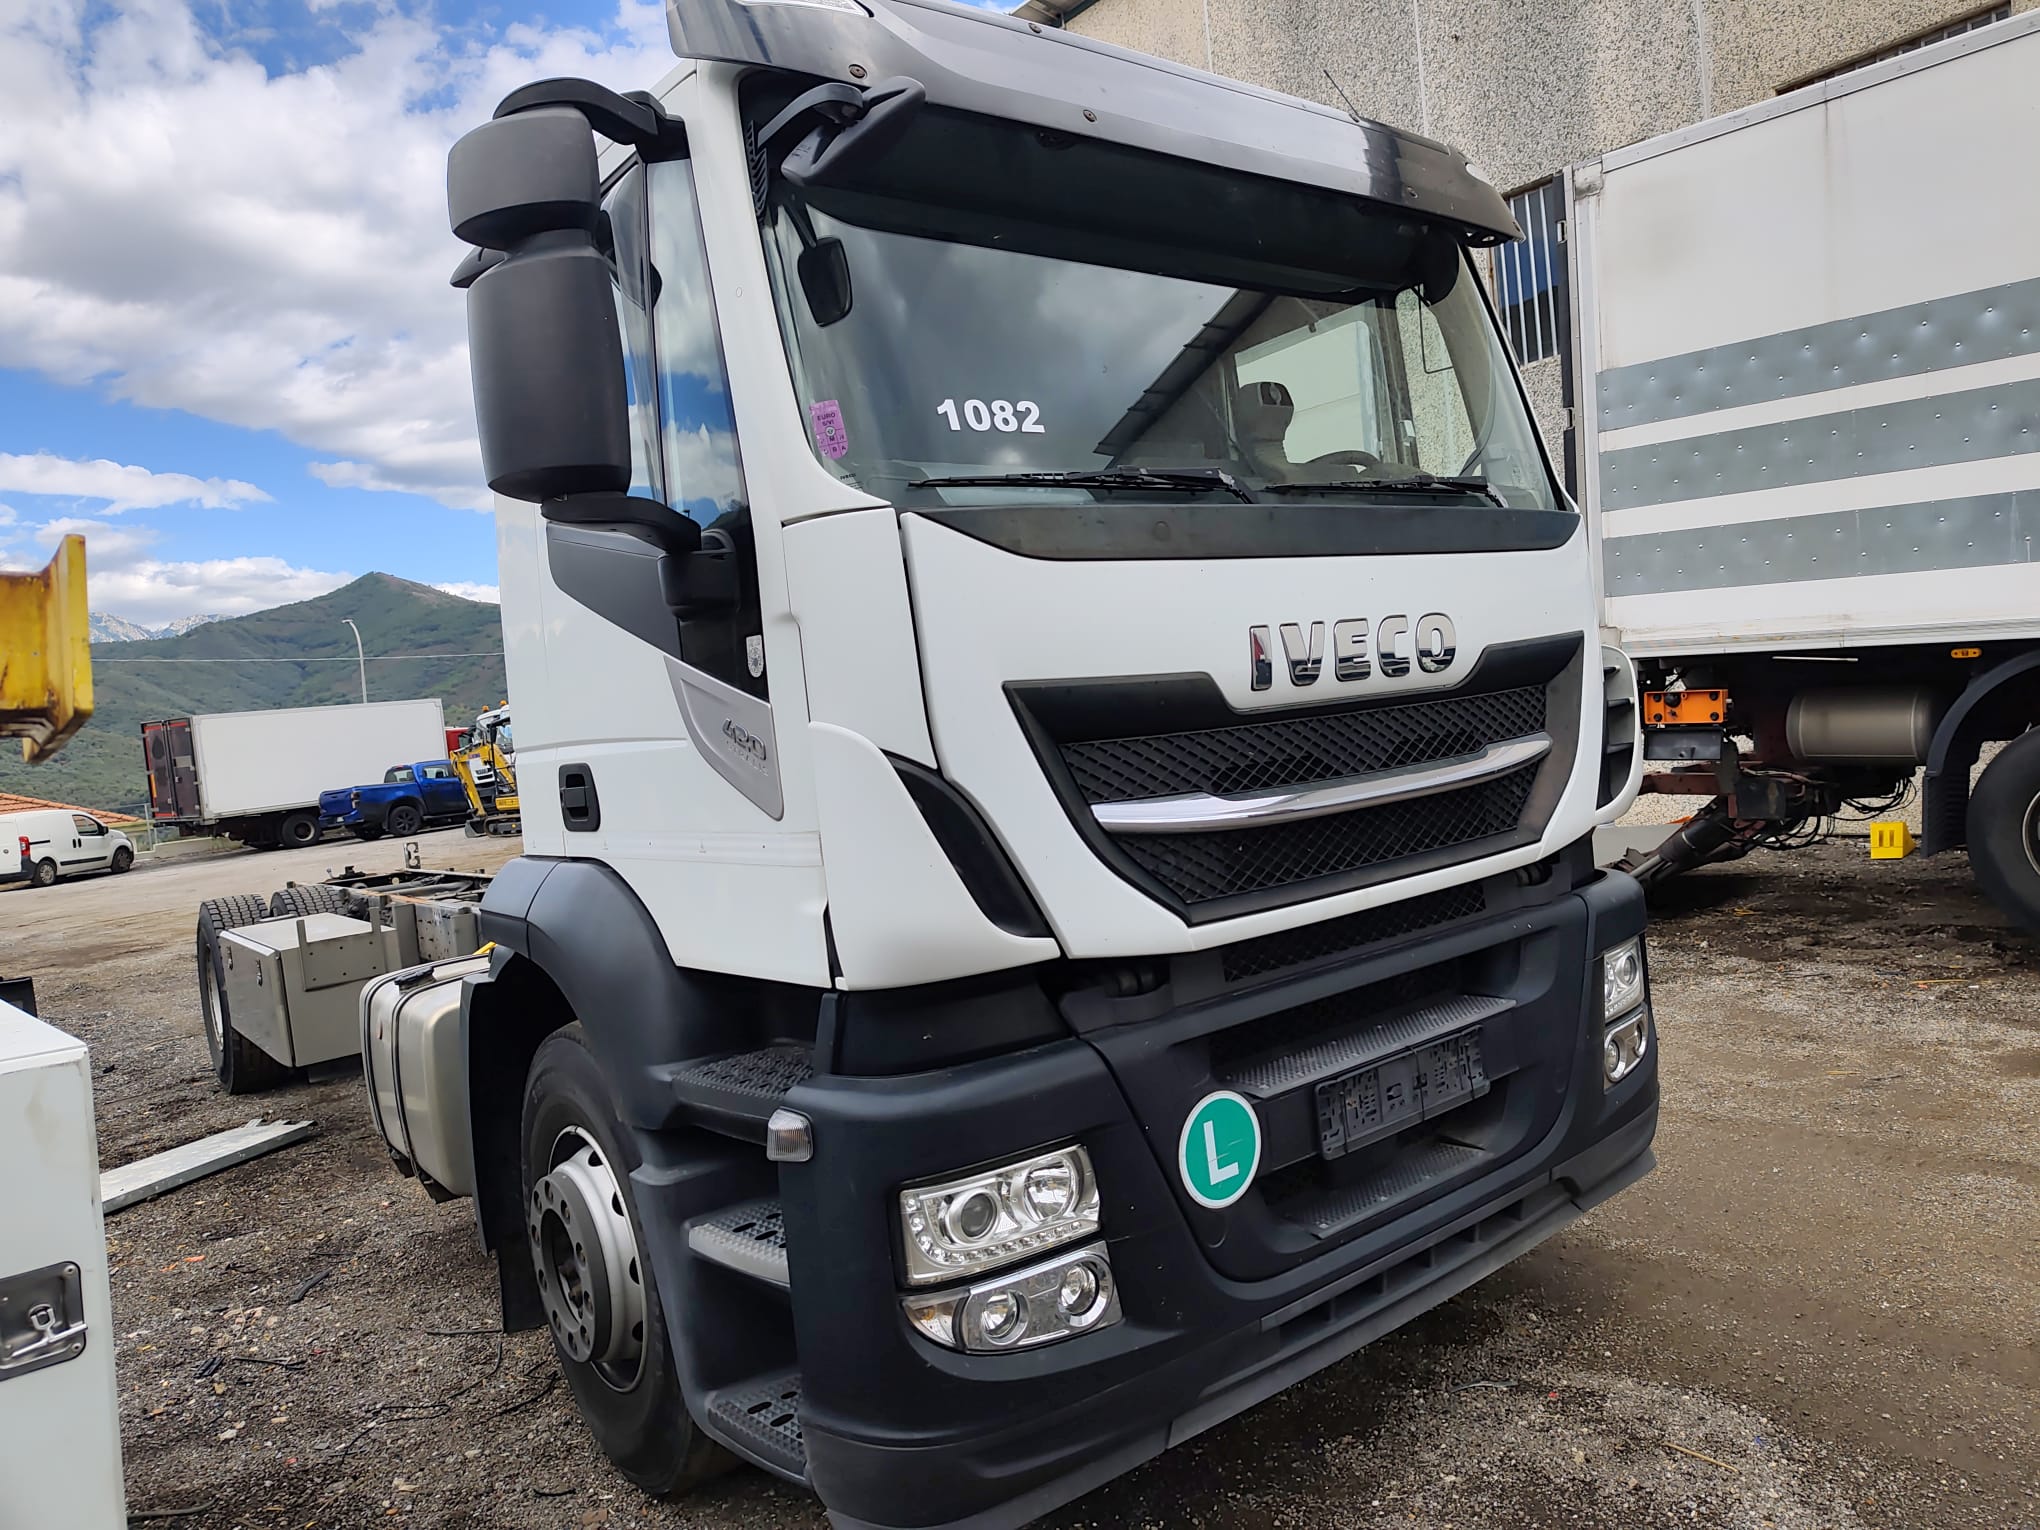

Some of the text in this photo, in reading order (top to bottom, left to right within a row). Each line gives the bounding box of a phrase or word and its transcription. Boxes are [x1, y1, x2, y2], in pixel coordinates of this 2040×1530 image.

[817, 412, 836, 421] EURO
[936, 398, 1046, 434] 1082
[1248, 612, 1457, 691] IVECO
[722, 717, 767, 761] 420
[1203, 1119, 1241, 1186] L
